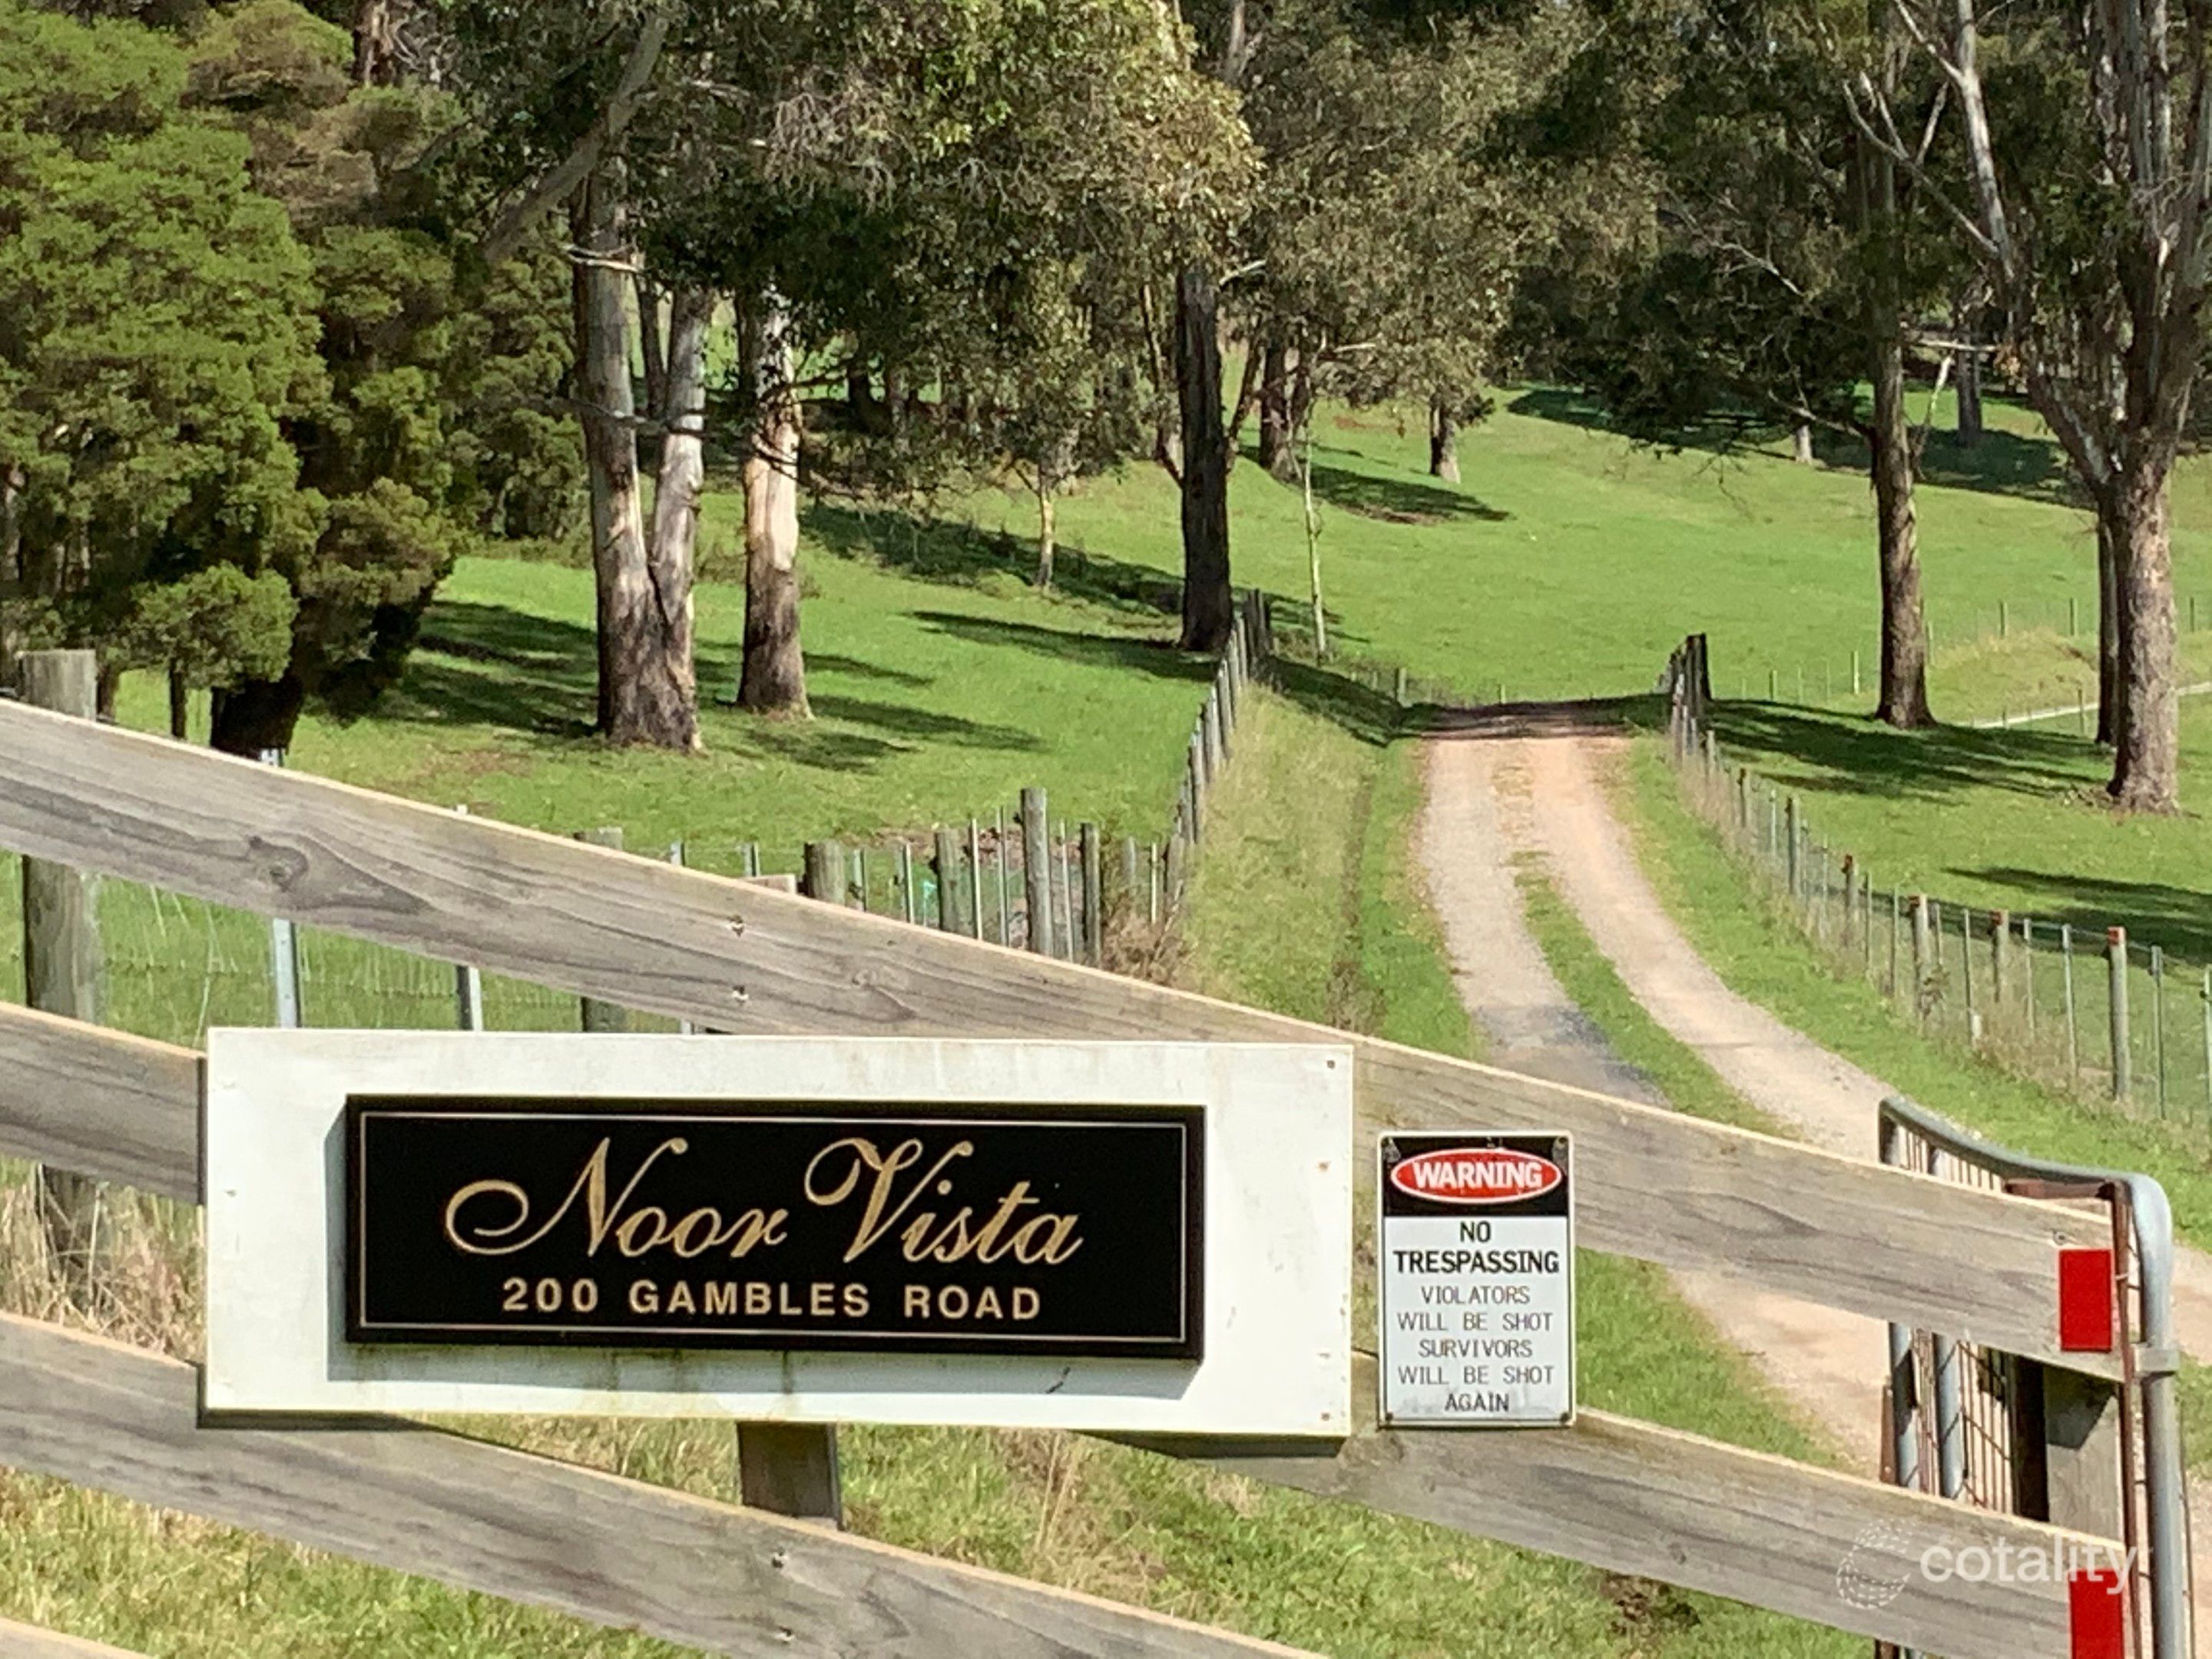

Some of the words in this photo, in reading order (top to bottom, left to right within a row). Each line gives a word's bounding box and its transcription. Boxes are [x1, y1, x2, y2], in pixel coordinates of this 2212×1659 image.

[1413, 1161, 1542, 1190] WARNING
[445, 1137, 787, 1257] Noor
[804, 1138, 1083, 1264] Vista
[1459, 1220, 1492, 1243] NO
[1392, 1250, 1560, 1275] TRESPASSING
[503, 1278, 598, 1312] 200
[630, 1280, 869, 1317] GAMBLES
[904, 1285, 1040, 1320] ROAD
[1421, 1285, 1531, 1305] VIOLATORS
[1397, 1311, 1448, 1331] WILL
[1463, 1312, 1488, 1331] BE
[1502, 1312, 1553, 1331] SHOT
[1419, 1339, 1533, 1359] SURVIVORS
[1398, 1366, 1449, 1386] WILL
[1463, 1366, 1488, 1385] BE
[1502, 1366, 1555, 1385] SHOT
[1444, 1392, 1510, 1412] AGAIN
